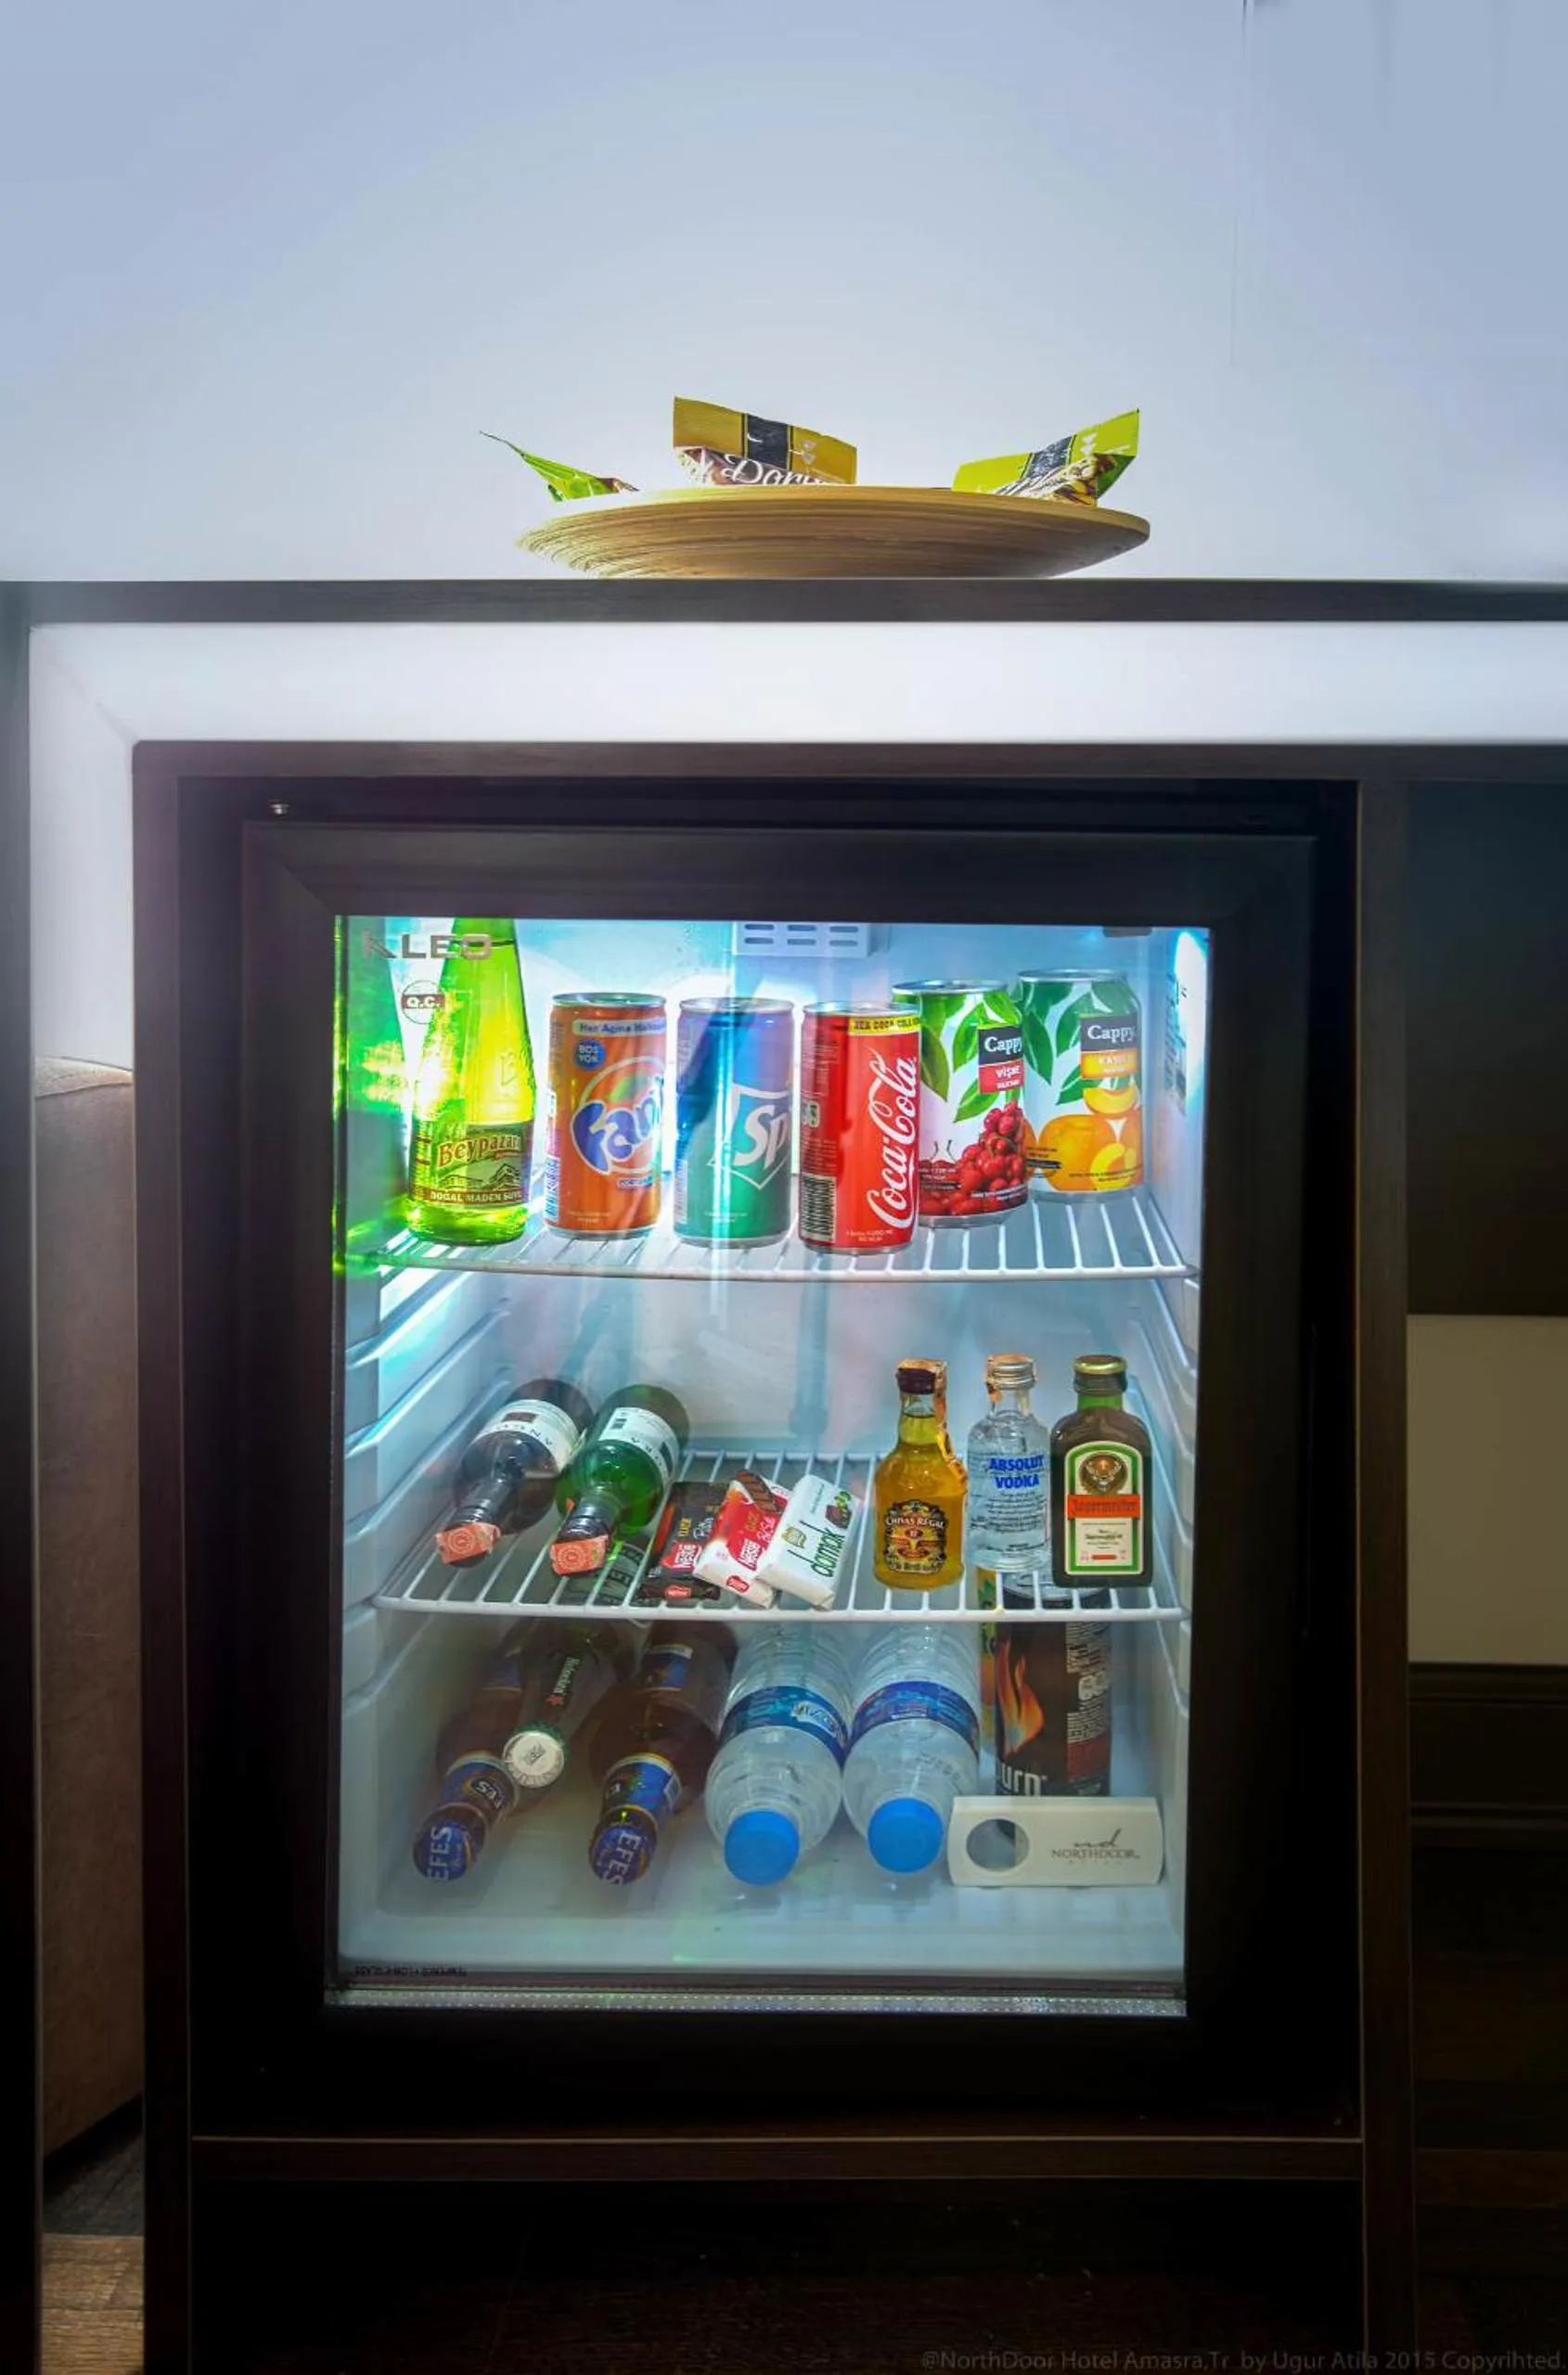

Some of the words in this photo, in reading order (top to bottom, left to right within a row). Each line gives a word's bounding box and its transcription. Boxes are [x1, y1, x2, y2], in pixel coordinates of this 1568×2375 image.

[361, 930, 493, 960] KLEO
[1087, 1024, 1137, 1043] Cappy
[988, 1455, 1045, 1471] ABSOLUT
[994, 1473, 1040, 1490] VODKA
[1001, 1762, 1041, 1797] urn
[427, 1825, 454, 1883] EFES
[602, 1829, 643, 1886] EFES
